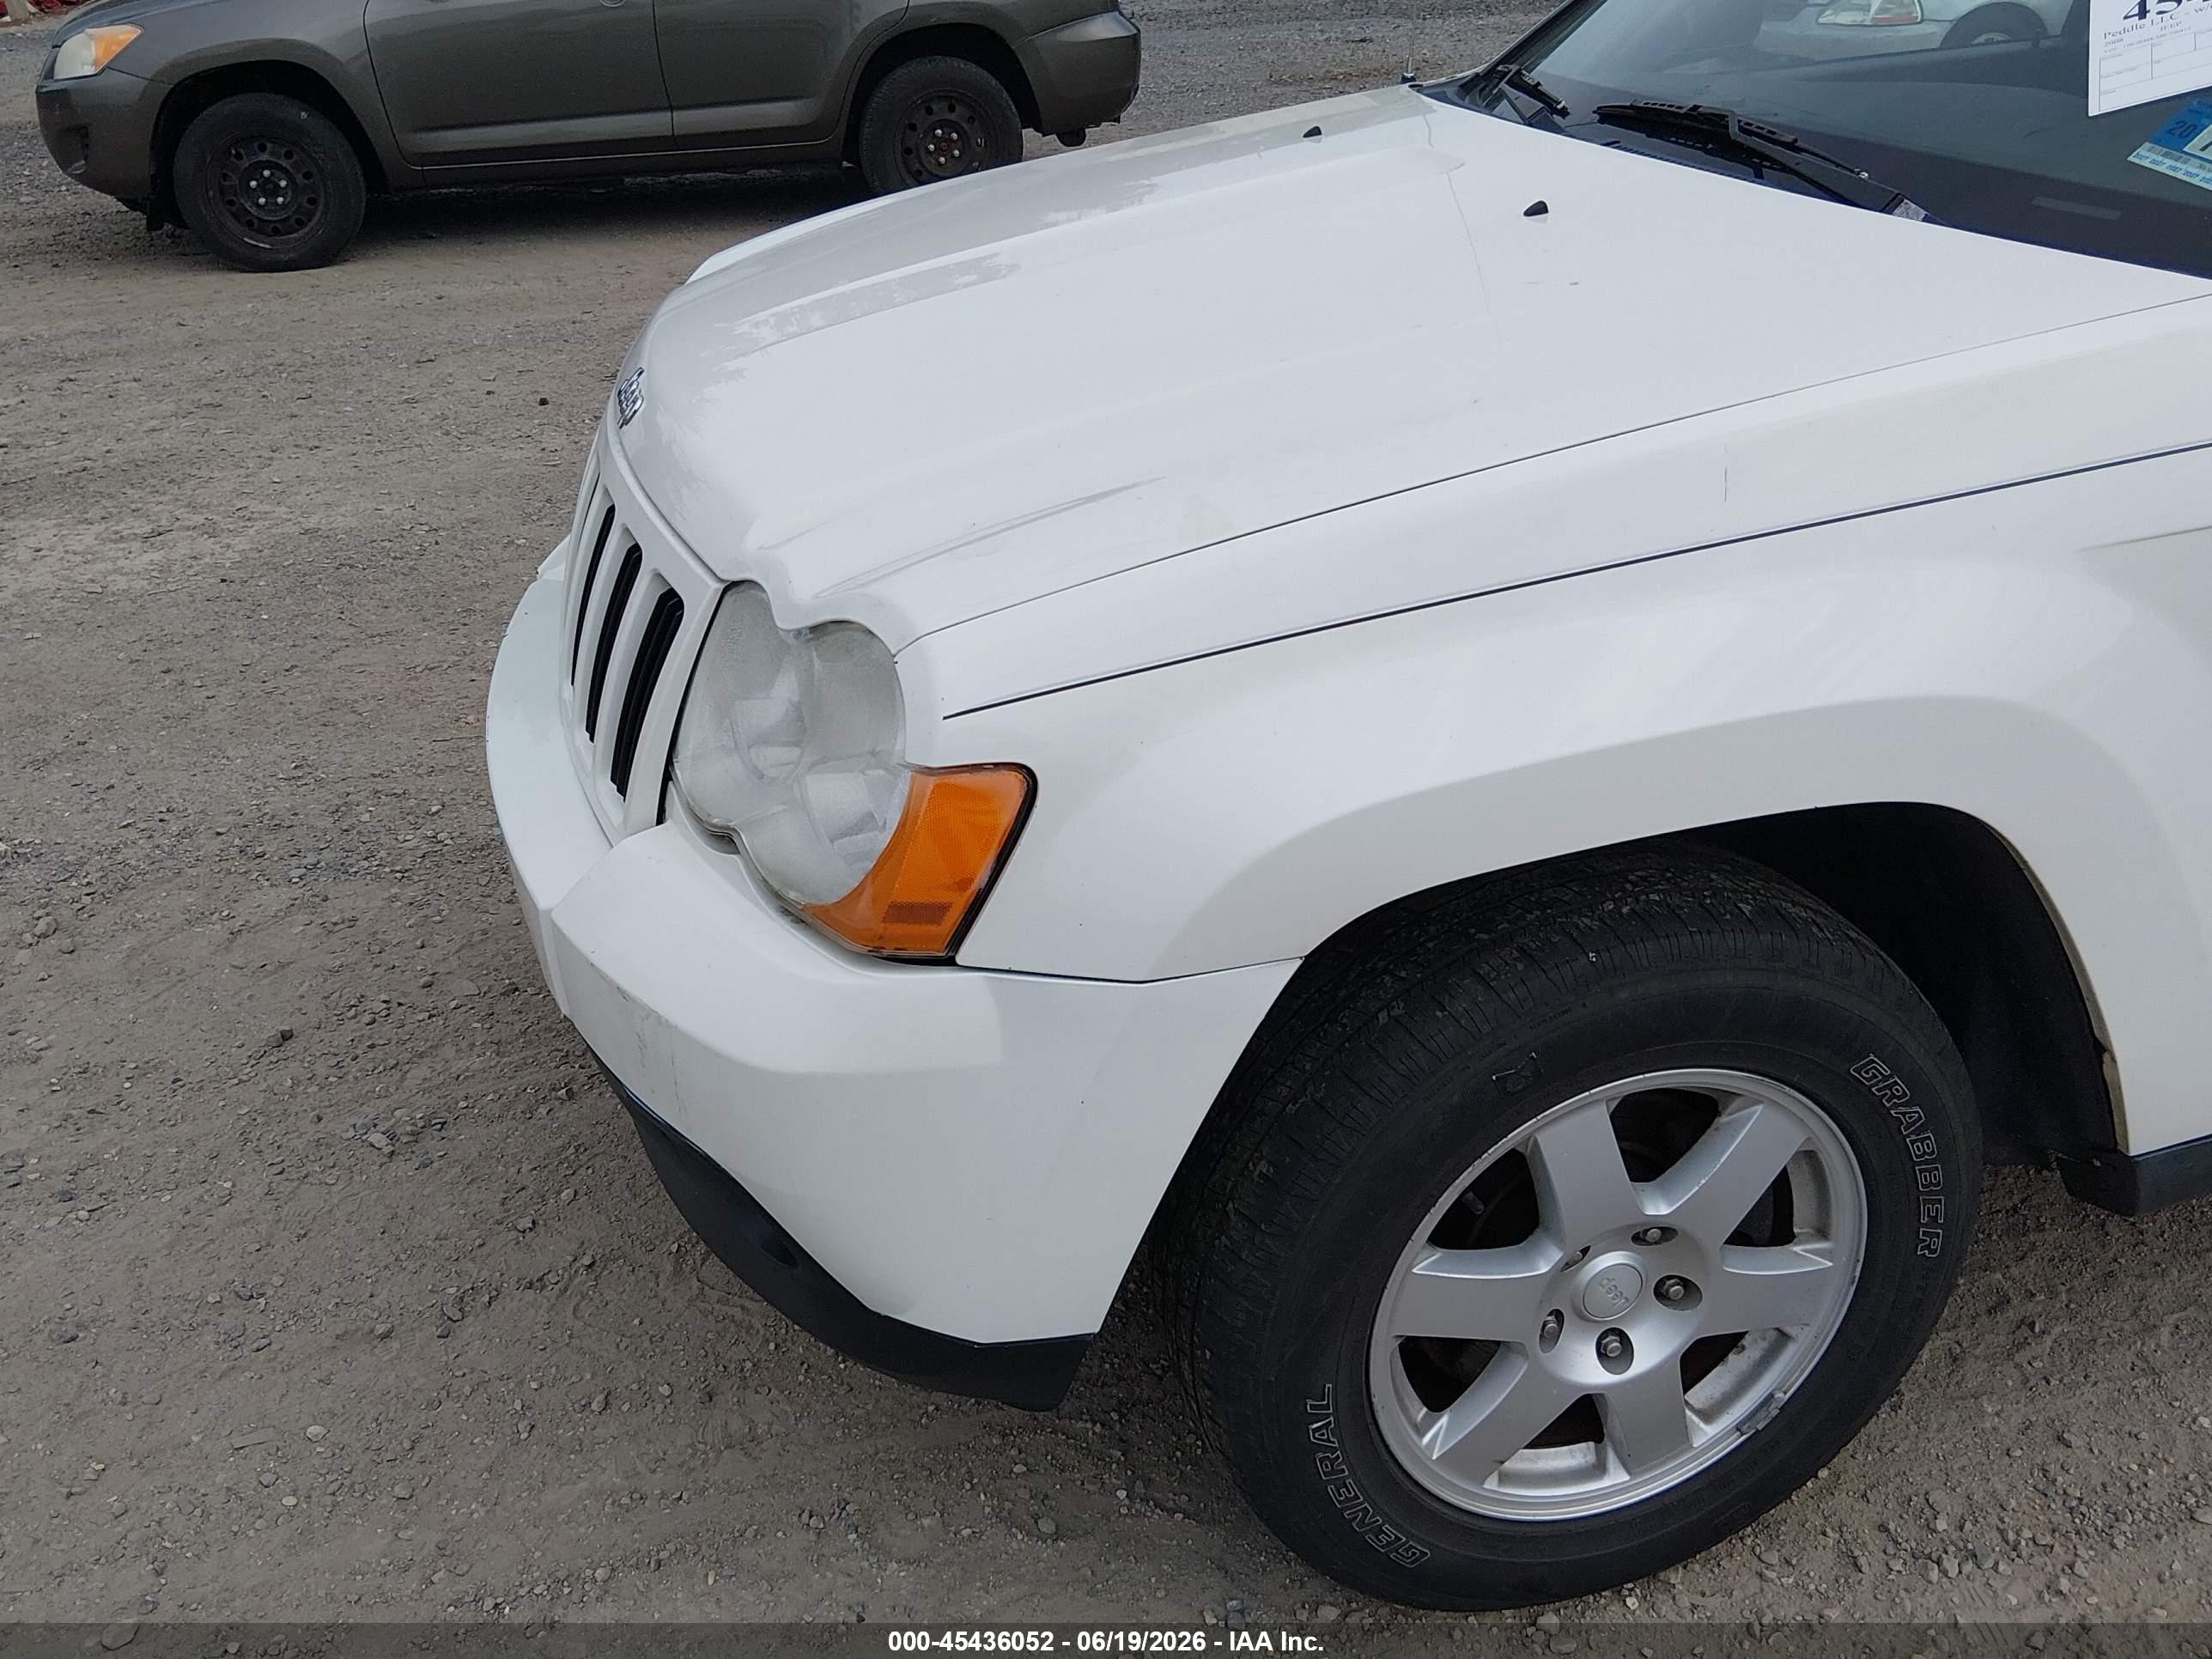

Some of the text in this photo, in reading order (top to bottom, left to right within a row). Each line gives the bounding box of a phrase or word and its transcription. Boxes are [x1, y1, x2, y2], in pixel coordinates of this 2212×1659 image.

[2103, 22, 2146, 40] Peddle
[2151, 12, 2179, 27] LLC
[2194, 2, 2212, 14] w/
[2123, 0, 2212, 21] 45
[1850, 1054, 1944, 1257] GRABBER
[1600, 1277, 1630, 1307] Jeep
[1306, 1384, 1431, 1567] GENERAL
